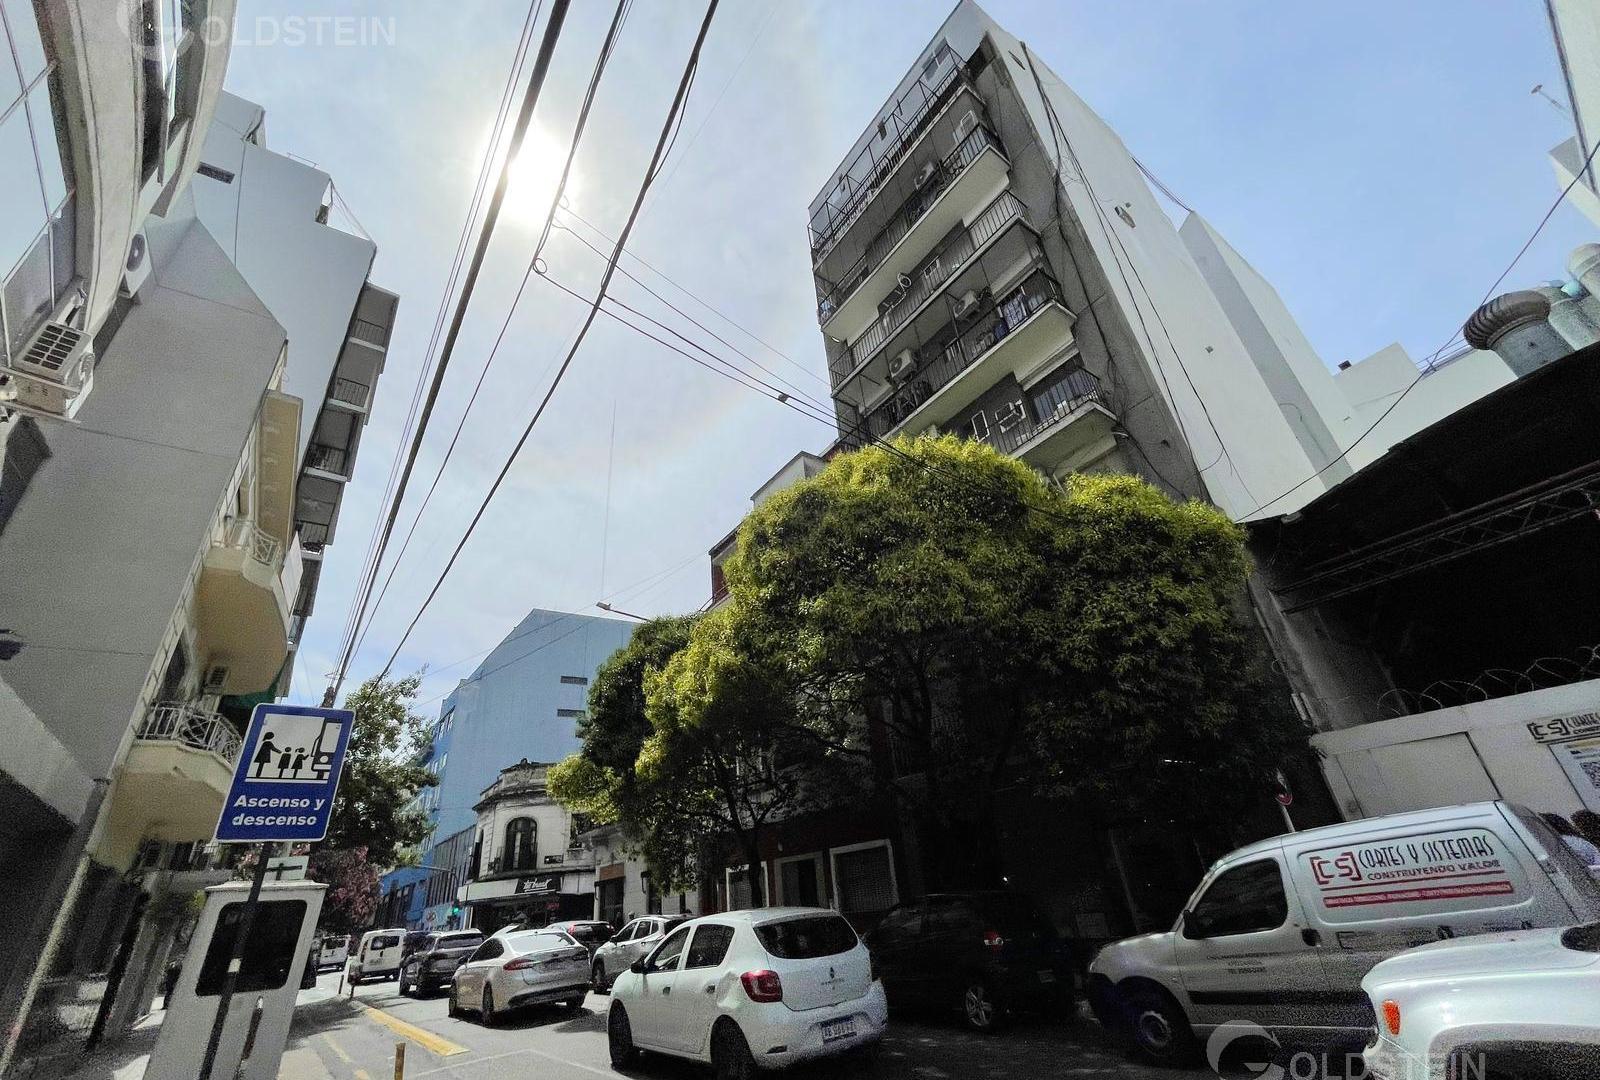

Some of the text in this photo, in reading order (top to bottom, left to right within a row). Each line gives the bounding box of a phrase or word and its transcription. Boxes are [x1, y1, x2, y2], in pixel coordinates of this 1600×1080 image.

[233, 794, 326, 811] Ascenso y
[231, 812, 318, 826] descenso
[1358, 844, 1406, 869] CORTES
[1406, 843, 1419, 864] Y
[1422, 834, 1495, 863] SISTEMAS
[1367, 863, 1456, 881] CONSTRUYENDO
